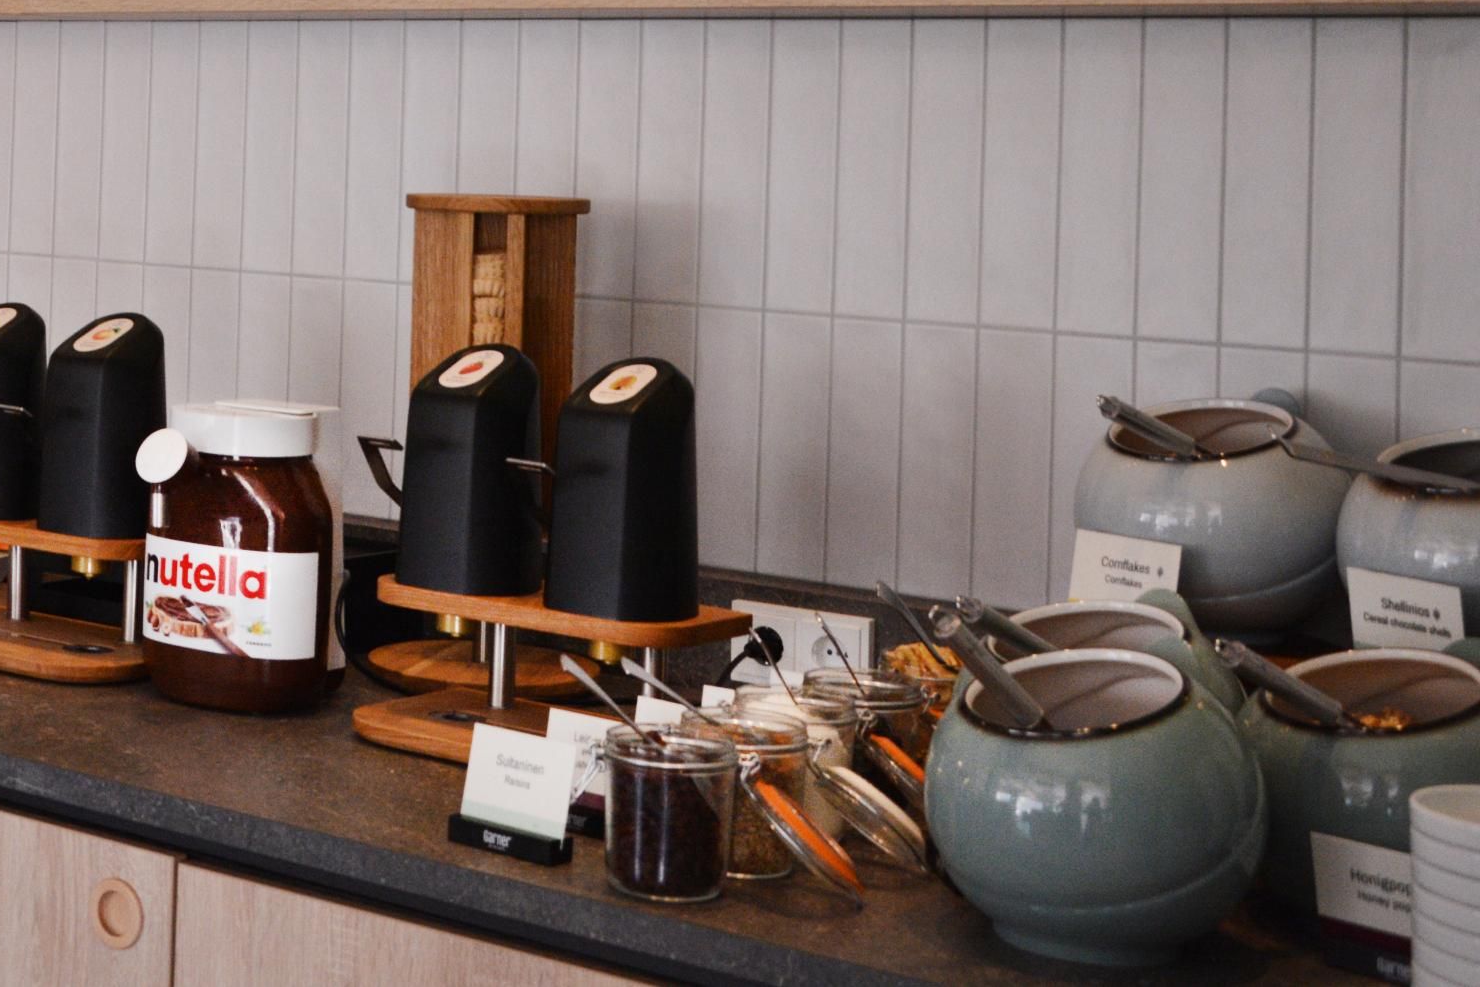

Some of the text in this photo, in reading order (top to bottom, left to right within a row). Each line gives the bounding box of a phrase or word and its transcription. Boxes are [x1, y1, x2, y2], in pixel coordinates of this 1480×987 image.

[1101, 555, 1151, 575] Cornflakes
[145, 551, 268, 601] nutella
[1104, 574, 1143, 589] Cornflakes
